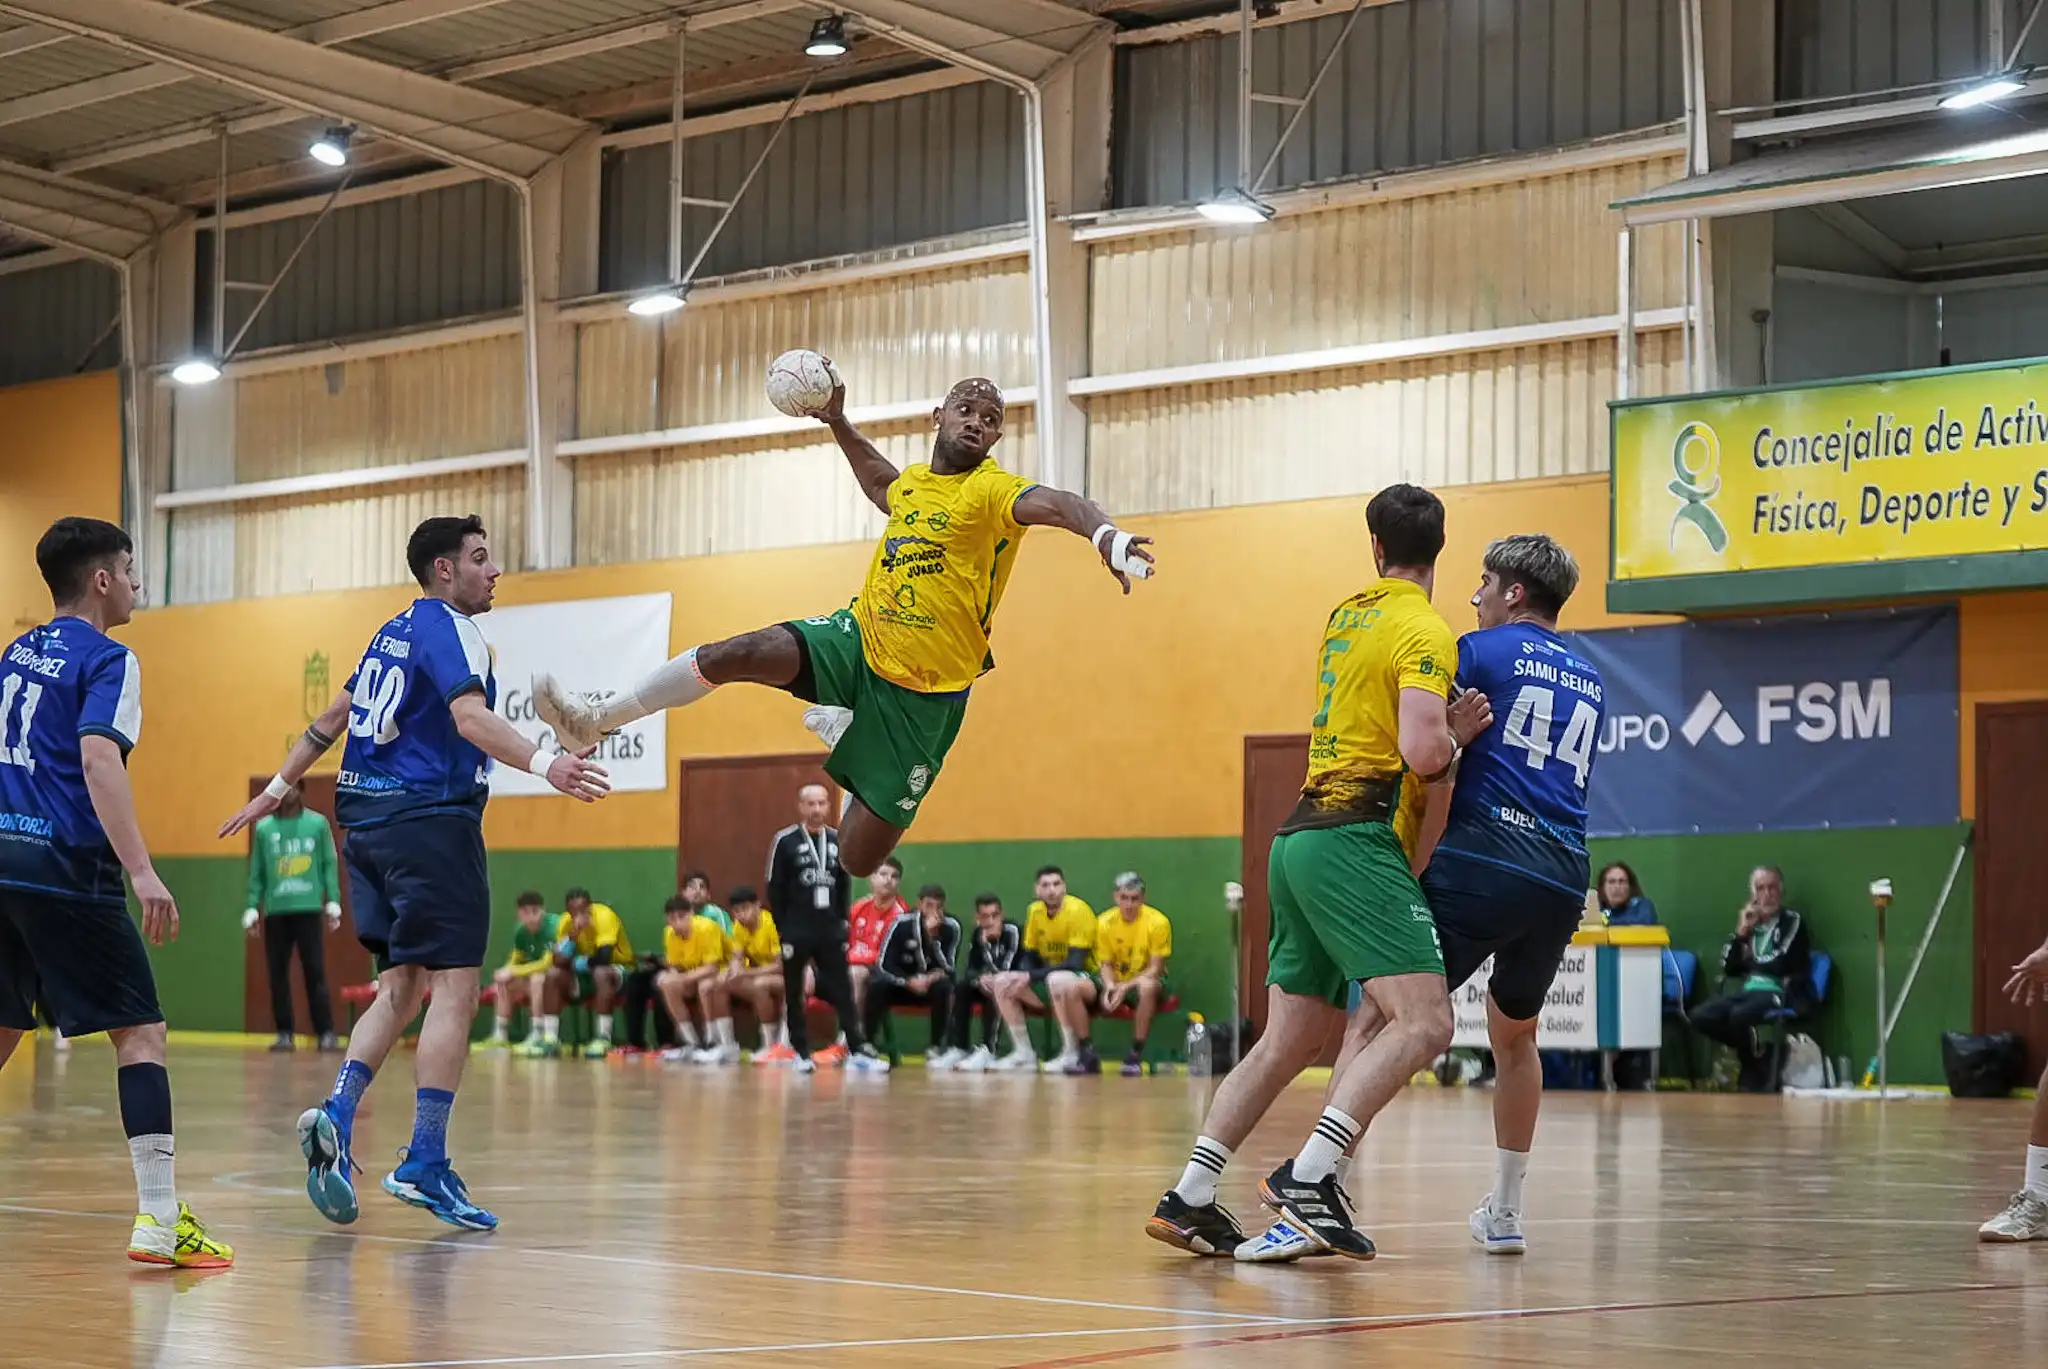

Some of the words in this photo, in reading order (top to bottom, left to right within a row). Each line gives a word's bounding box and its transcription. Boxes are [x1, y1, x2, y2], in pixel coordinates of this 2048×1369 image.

[1753, 414, 1912, 472] Concejalía
[1924, 408, 1964, 453] de
[1753, 490, 1849, 536] Física,
[1859, 481, 1990, 534] Deporte
[2002, 485, 2020, 526] y
[347, 658, 406, 745] 90
[1513, 659, 1558, 683] SAMU
[1560, 671, 1602, 703] SEIJAS
[1757, 677, 1892, 745] FSM
[0, 672, 43, 777] 11
[1503, 684, 1599, 789] 44
